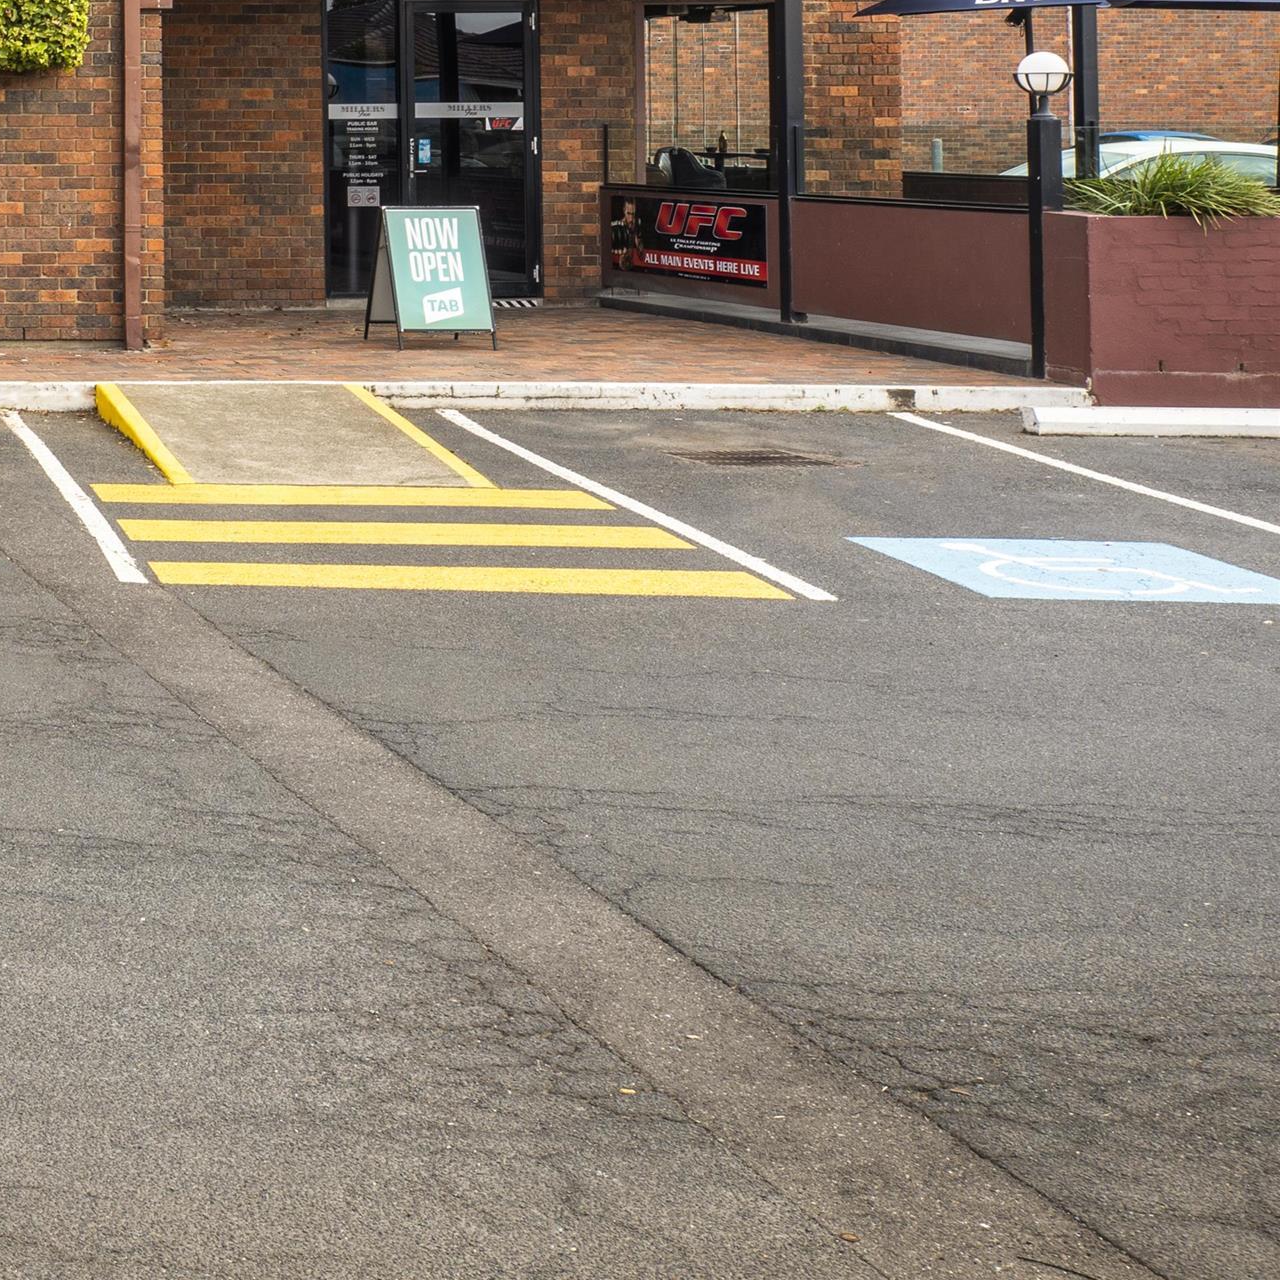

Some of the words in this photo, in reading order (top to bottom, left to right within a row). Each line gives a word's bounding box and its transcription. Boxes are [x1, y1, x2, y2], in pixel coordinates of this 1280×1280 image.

[447, 104, 492, 112] MILLERS
[492, 119, 513, 129] UFC
[654, 201, 748, 241] UFC
[404, 217, 459, 250] NOW
[670, 237, 696, 245] ULTIMATE
[408, 251, 465, 282] OPEN
[644, 253, 659, 265] ALL
[660, 254, 682, 267] MAIN
[683, 256, 714, 271] EVENTS
[716, 260, 738, 274] HERE
[740, 263, 760, 276] LIVE
[427, 299, 459, 312] TAB
